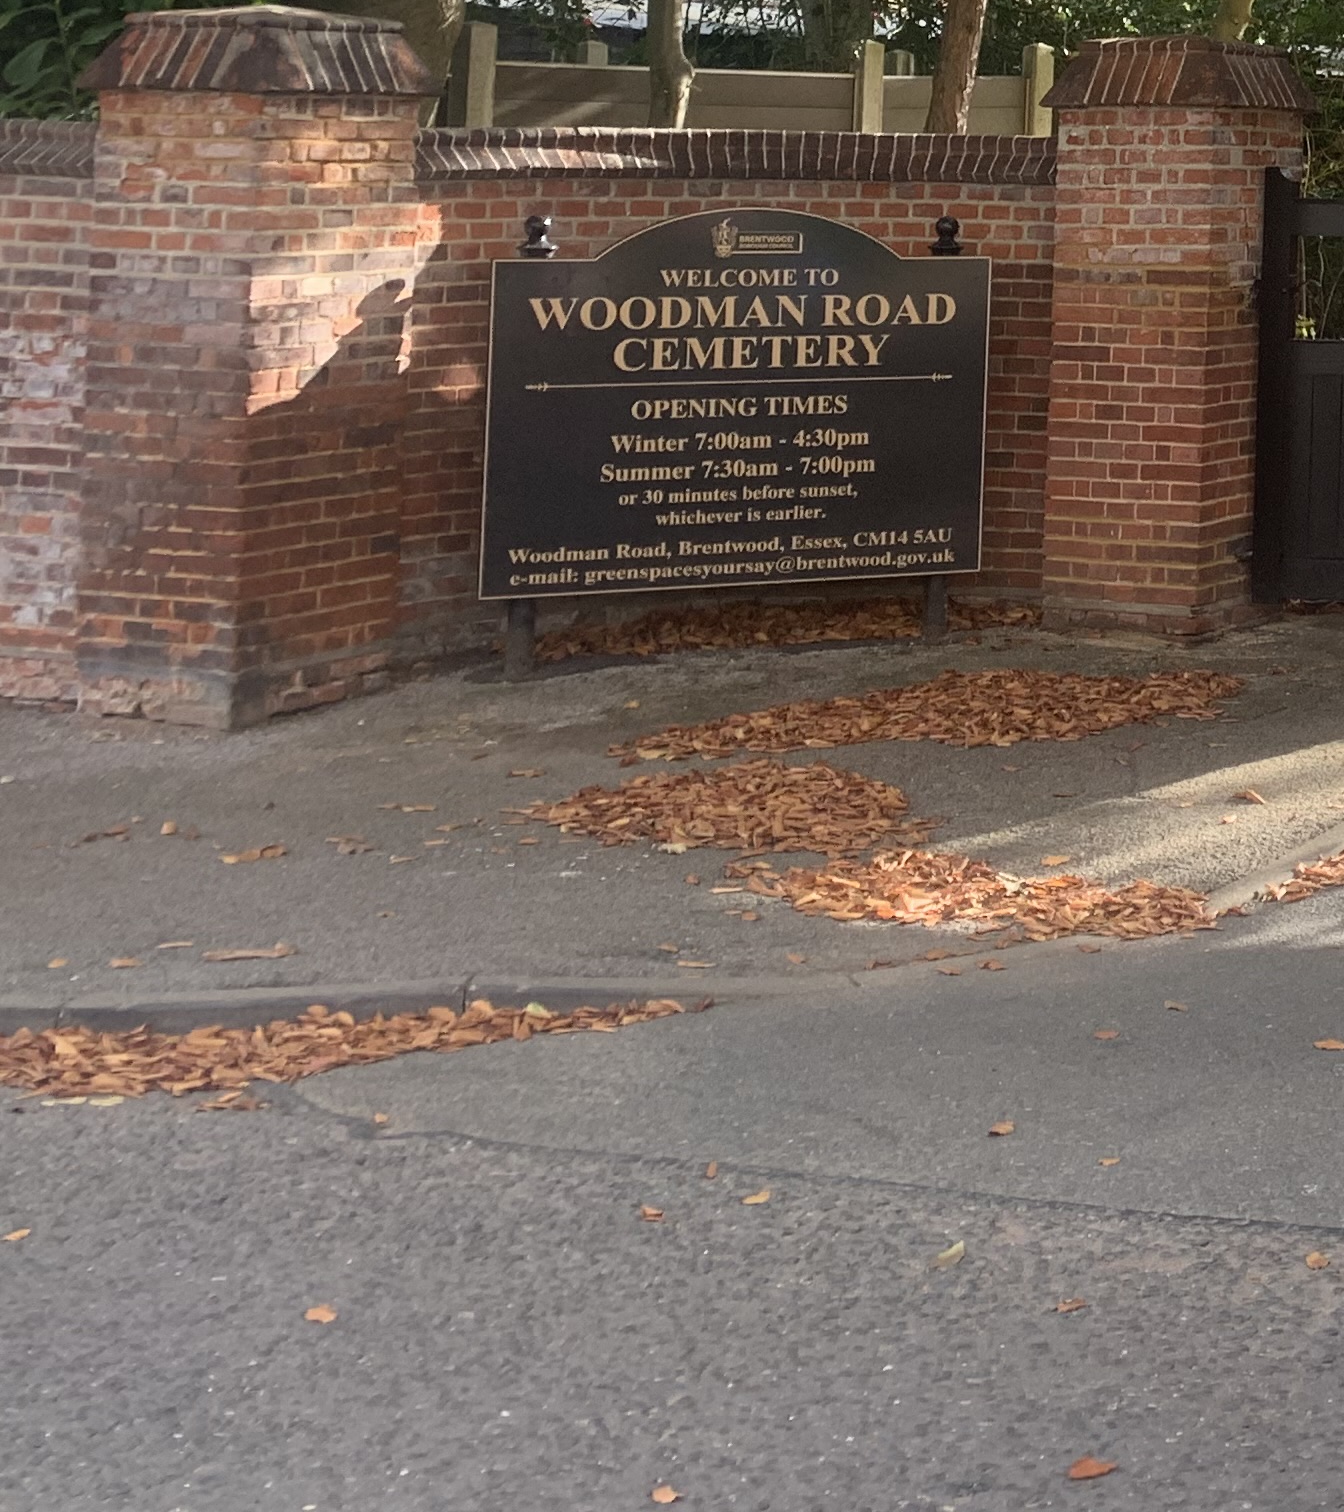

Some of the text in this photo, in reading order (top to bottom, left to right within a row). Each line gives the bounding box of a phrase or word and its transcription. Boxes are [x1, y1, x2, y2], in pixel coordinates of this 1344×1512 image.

[739, 235, 794, 243] BRENTWOOD
[660, 268, 839, 287] WELCOME TO
[529, 293, 957, 331] WOODMAN ROAD
[613, 334, 890, 372] CEMETERY
[631, 394, 848, 420] OPENING TIMES
[611, 434, 689, 453] Winter
[694, 431, 772, 451] 7:00am
[792, 428, 869, 450] 4:30pm
[600, 463, 695, 483] Summer
[701, 459, 778, 479] 7:30am
[800, 455, 875, 477] 7:00pm
[618, 482, 858, 506] or 30 minutes before sunset,
[655, 504, 826, 526] whichever is earlier.
[508, 527, 952, 564] Woodman Road, Brentwood, Essex, CM14 5AU
[509, 548, 955, 586] e-mail: greenspacesyoursay@brentwood.gov.uk
